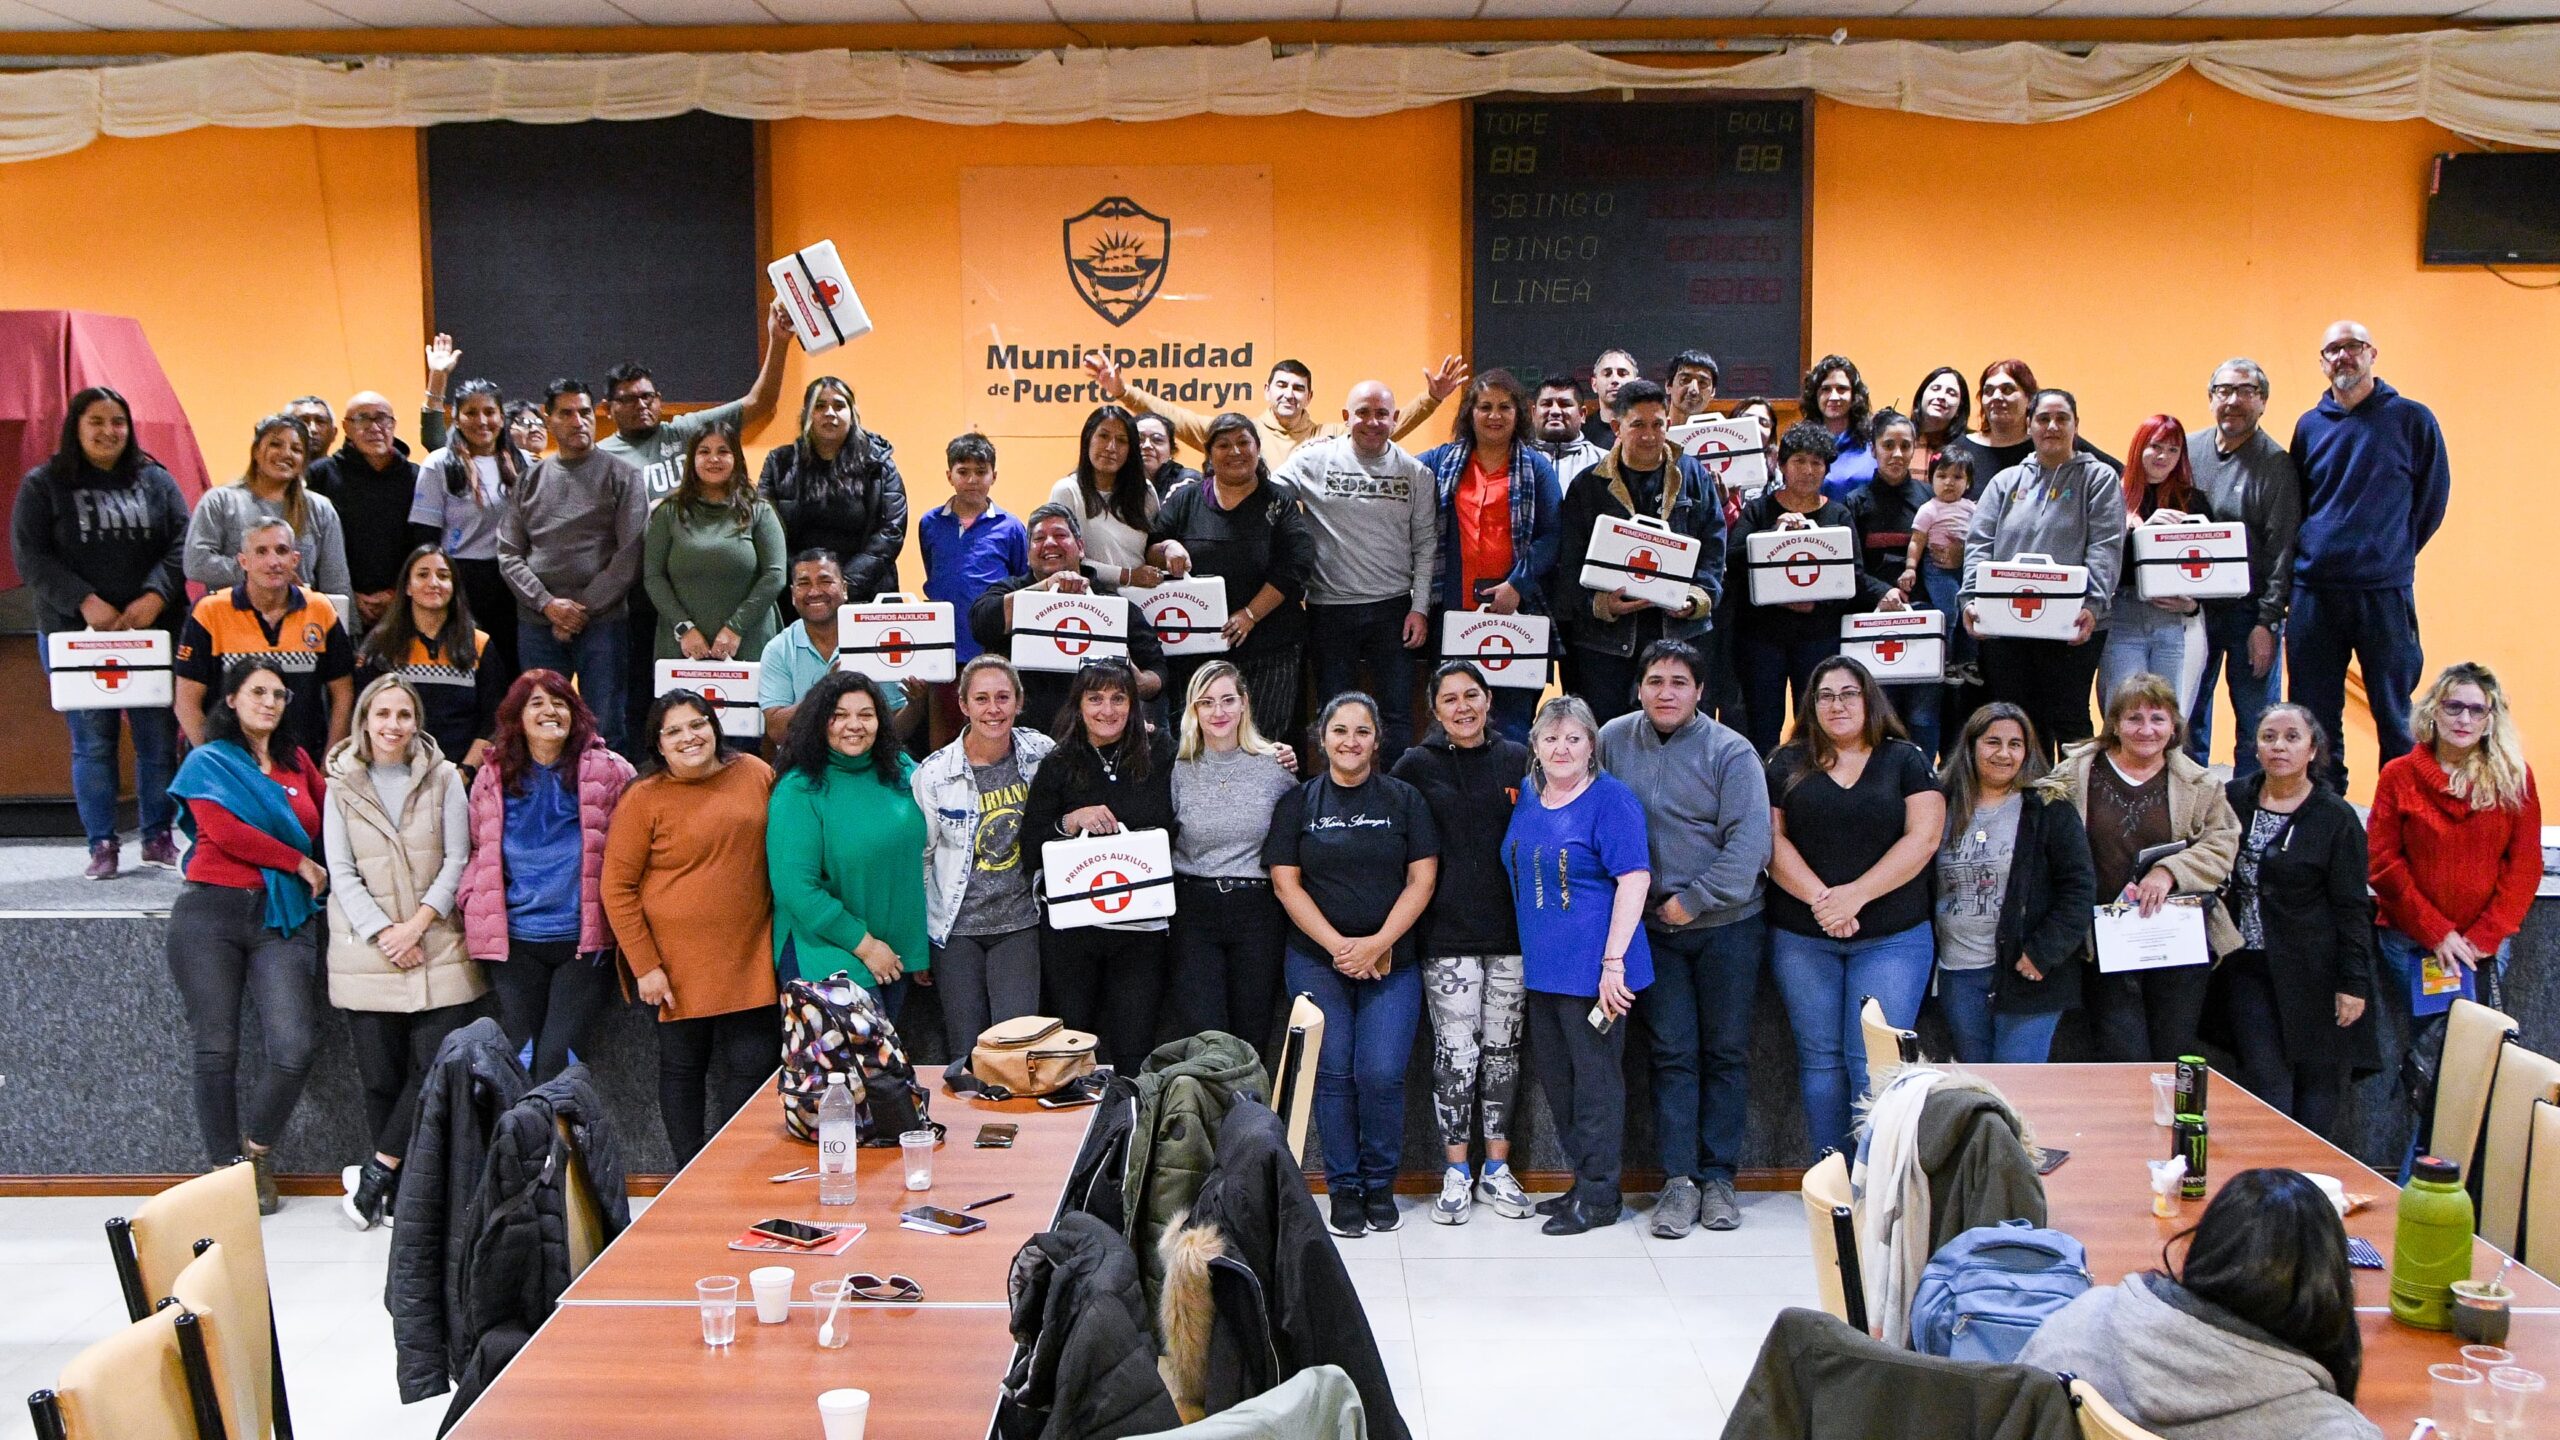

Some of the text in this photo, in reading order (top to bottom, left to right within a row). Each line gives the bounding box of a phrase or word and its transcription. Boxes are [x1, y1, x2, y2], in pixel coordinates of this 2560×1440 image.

[1485, 113, 1548, 134] TOPE
[1727, 112, 1794, 132] BOLA
[1491, 193, 1613, 219] SBINGO
[1491, 236, 1598, 261] BINGO
[1491, 279, 1591, 303] LINEA
[987, 383, 1010, 396] de
[1132, 378, 1253, 408] Madryn
[1681, 426, 1748, 446] IMEROS AUXILIOS
[1766, 537, 1838, 561] PRIMEROS AUXILIOS
[1035, 600, 1114, 627] PRIMEROS AUXILIOS
[1140, 592, 1209, 611] IMEROS AUXILIOS
[861, 613, 930, 622] PRIMEROS AUXILIOS
[1460, 620, 1535, 644] PRIMEROS AUXILIOS
[979, 782, 1028, 813] IRVANA
[1065, 852, 1153, 884] PRIMEROS AUXILIOS
[823, 1140, 846, 1154] ECO
